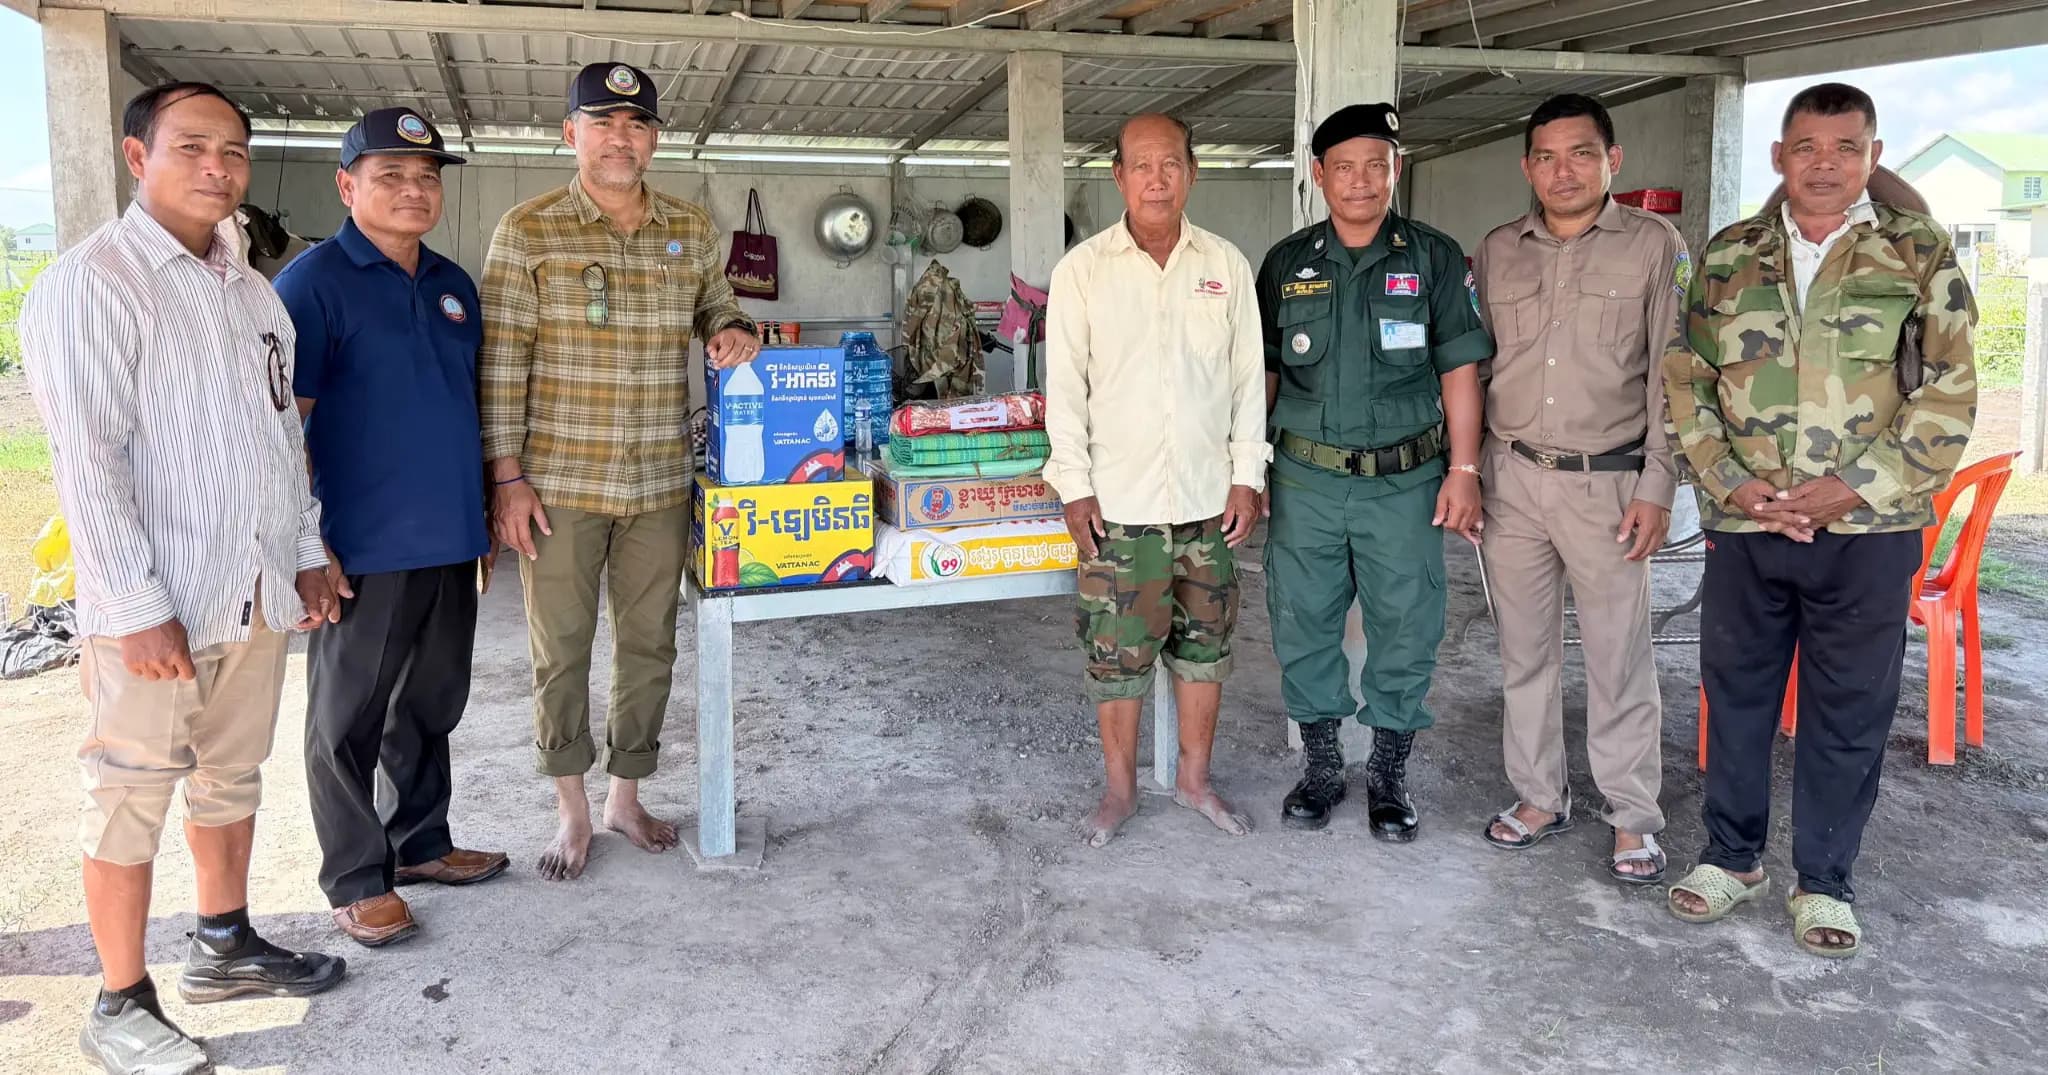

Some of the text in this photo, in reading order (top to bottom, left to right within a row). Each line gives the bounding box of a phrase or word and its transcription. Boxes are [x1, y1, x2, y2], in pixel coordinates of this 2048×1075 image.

[725, 401, 764, 410] V-ACTIVE
[773, 438, 811, 446] VATTANAC
[718, 522, 734, 536] V
[776, 560, 821, 569] VATTANAC
[941, 558, 958, 571] 99
